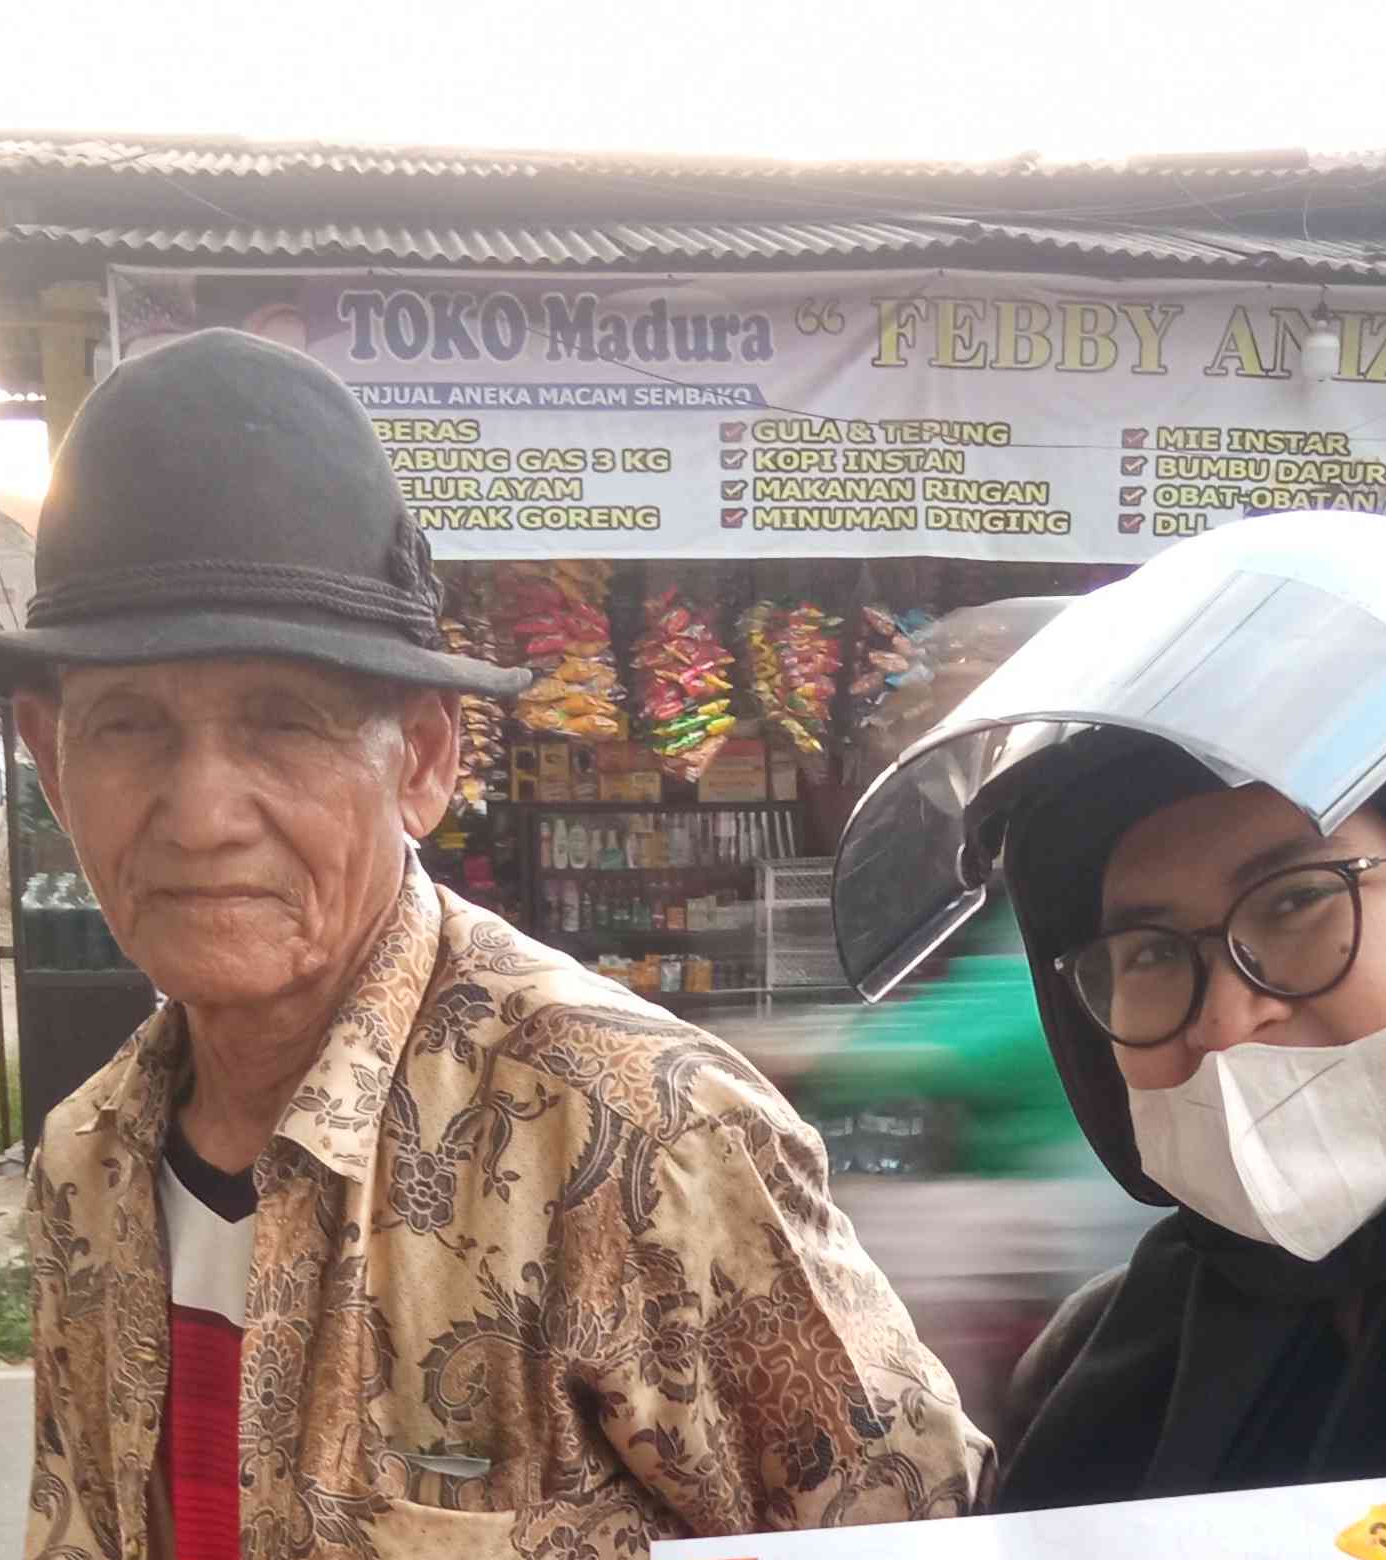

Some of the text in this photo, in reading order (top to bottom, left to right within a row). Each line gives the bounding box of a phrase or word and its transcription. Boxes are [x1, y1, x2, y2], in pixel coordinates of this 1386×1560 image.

[338, 290, 774, 365] TOKO Madura
[870, 297, 1185, 375] FEBBY
[448, 387, 532, 405] ANEKA
[538, 387, 628, 406] MACAM
[634, 387, 752, 408] SEMBAKO
[373, 419, 480, 442] BERAS
[753, 420, 1011, 446] GULA & TEPUNG
[1156, 426, 1351, 455] MIE INSTAR
[517, 448, 587, 472] GAS
[591, 449, 616, 472] 3
[621, 448, 671, 472] KG
[753, 449, 965, 473] KOPI INSTAN
[1156, 456, 1270, 481] BUMBU
[400, 477, 583, 502] ELUR AYAM
[753, 477, 1050, 504] MAKANAN RINGAN
[1154, 483, 1378, 511] OBAT-OBATAN
[517, 506, 661, 531] GORENG
[753, 506, 1071, 534] MINUMAN DINGING
